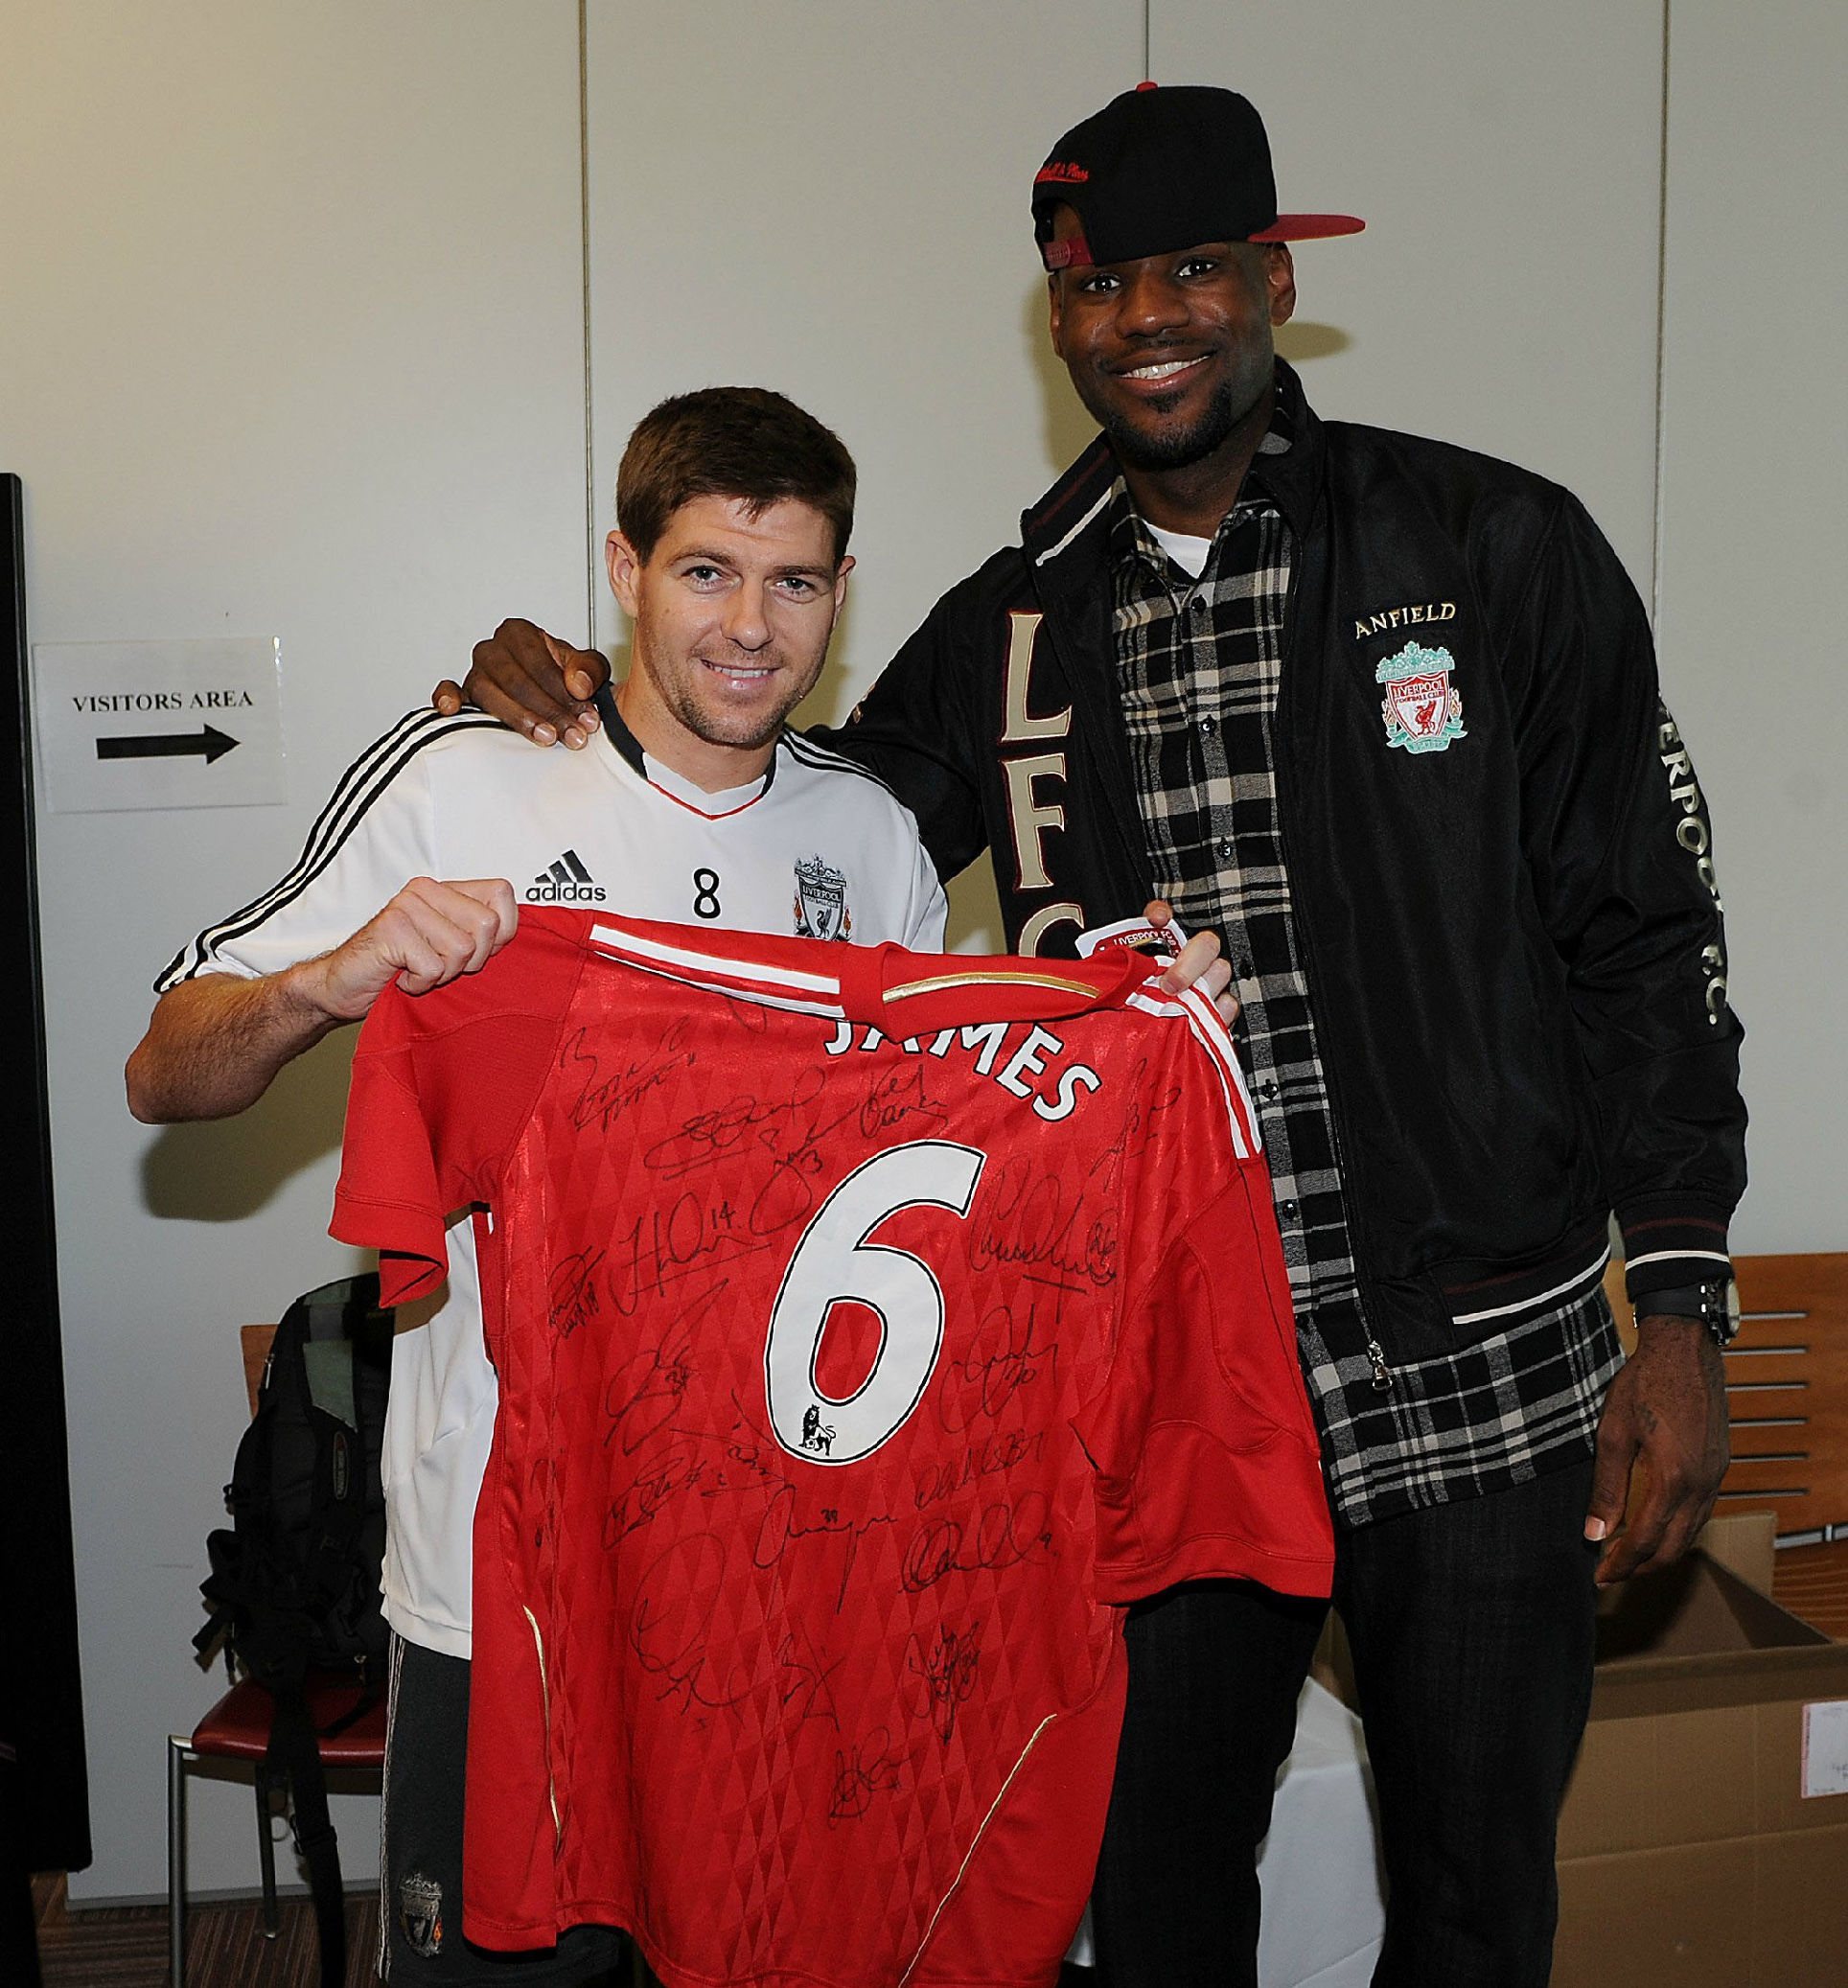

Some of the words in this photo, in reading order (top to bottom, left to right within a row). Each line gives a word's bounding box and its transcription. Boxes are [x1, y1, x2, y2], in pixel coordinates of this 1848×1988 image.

[1354, 602, 1456, 640] ANFIELD
[72, 693, 183, 712] VISITORS
[190, 690, 254, 708] AREA
[1392, 680, 1444, 699] LIVERPOOL
[525, 882, 607, 902] adidas
[693, 867, 722, 919] 8
[764, 1139, 987, 1467] 6
